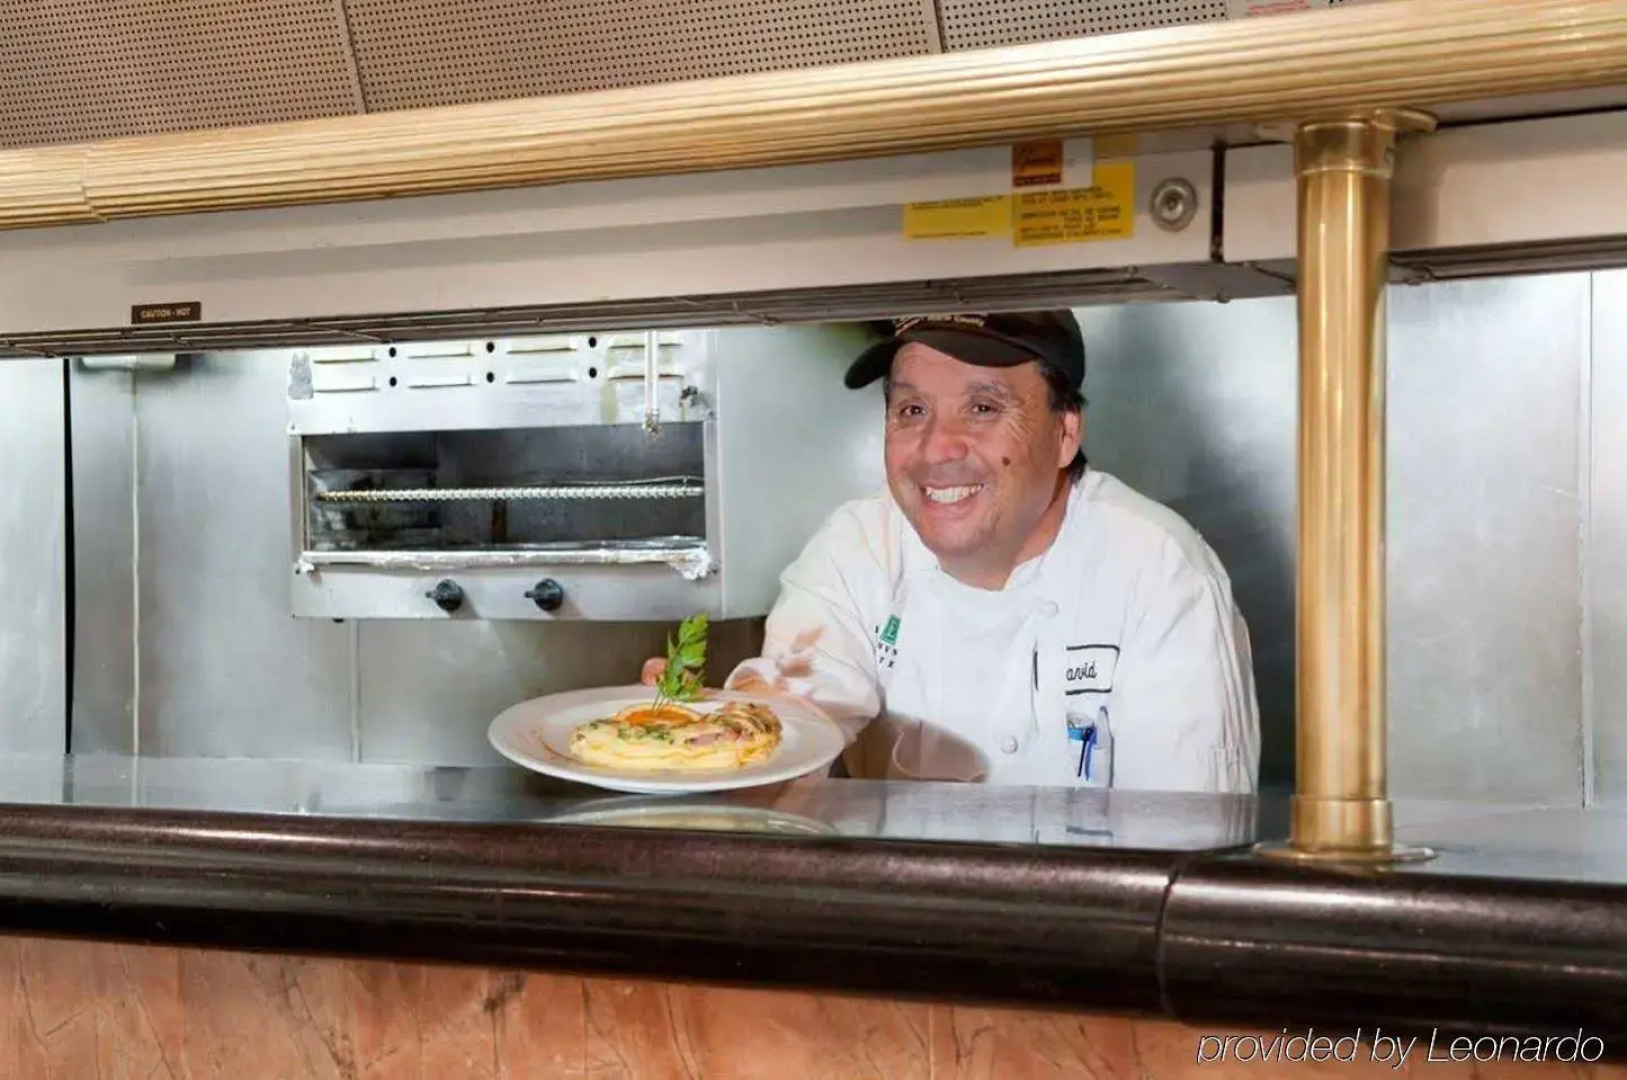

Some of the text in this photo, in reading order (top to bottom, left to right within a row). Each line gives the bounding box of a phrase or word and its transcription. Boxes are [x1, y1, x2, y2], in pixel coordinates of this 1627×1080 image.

[141, 307, 191, 319] CAUTION HOT
[1066, 661, 1098, 681] avid
